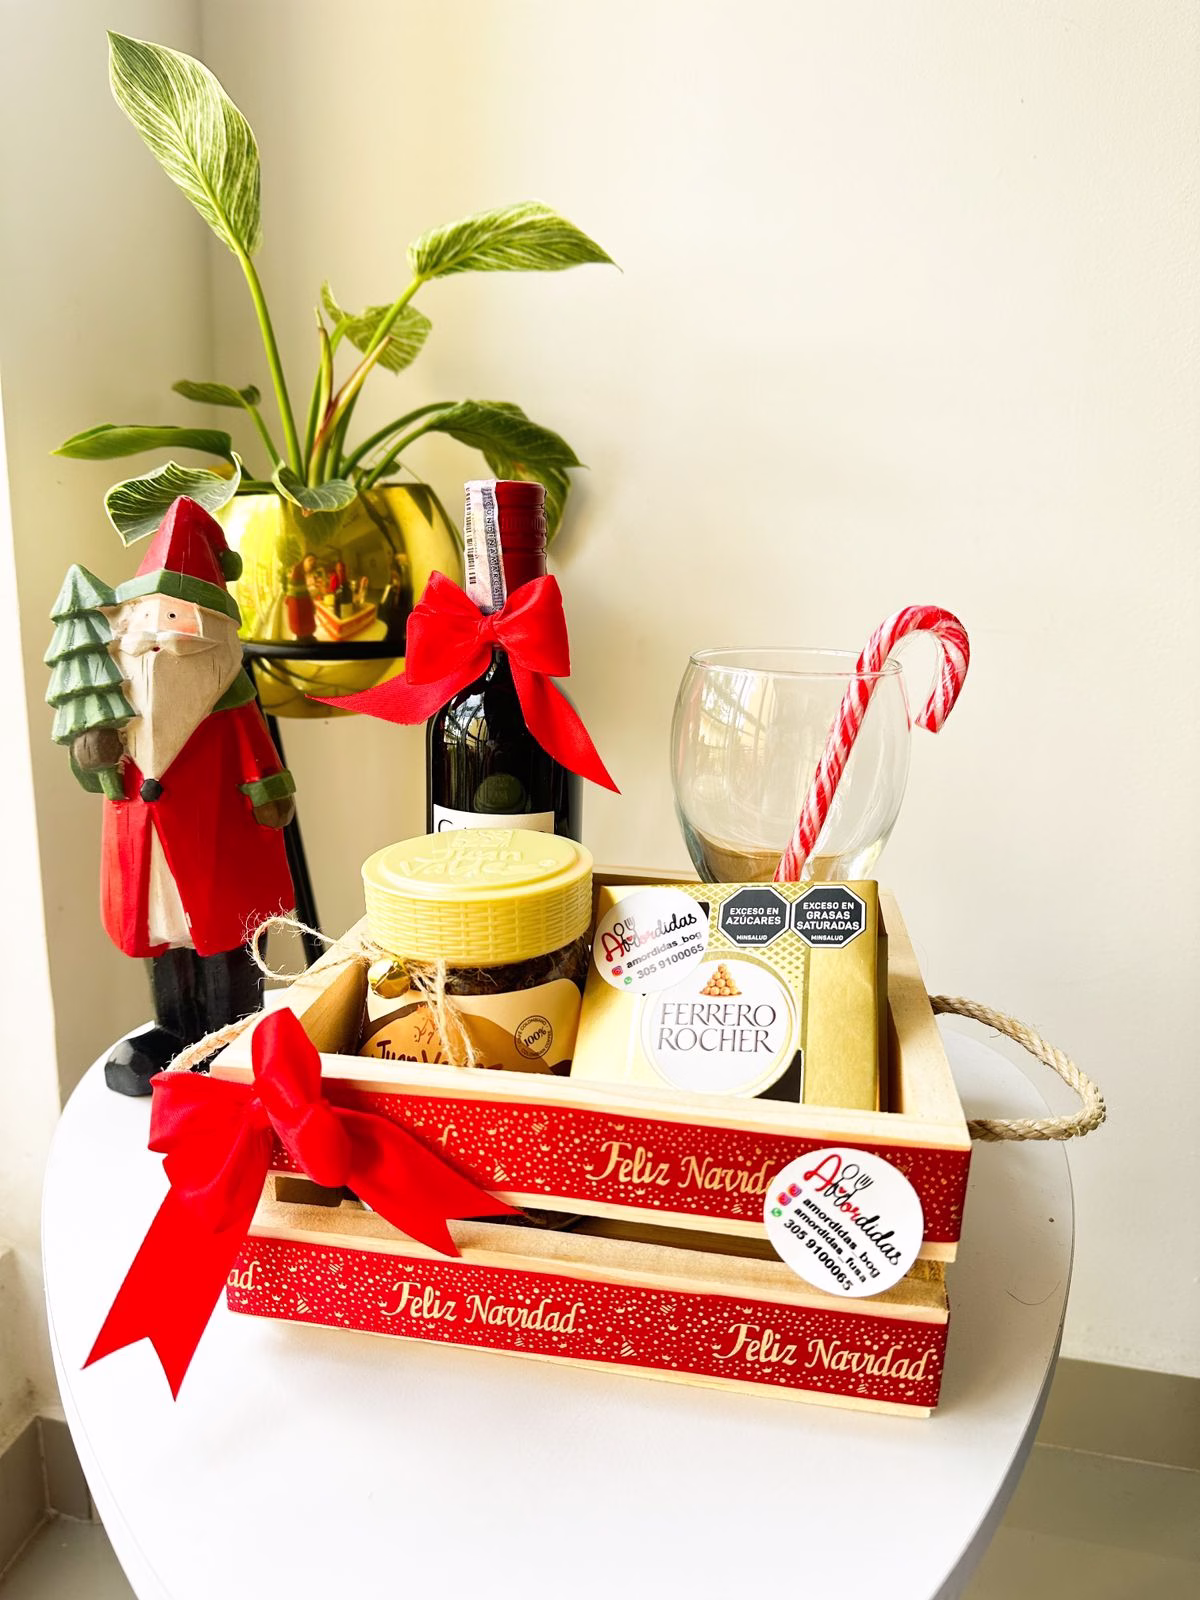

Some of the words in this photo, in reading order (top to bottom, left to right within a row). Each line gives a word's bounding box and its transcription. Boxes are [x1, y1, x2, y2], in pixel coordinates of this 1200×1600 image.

[486, 501, 501, 595] CUNDINAMARCA
[729, 907, 765, 915] EXCESO
[766, 907, 779, 915] EN
[802, 902, 839, 910] EXCESO
[841, 902, 855, 910] EN
[806, 911, 851, 920] GRASAS
[725, 914, 782, 925] AZÚCARES
[796, 921, 860, 930] SATURADAS
[636, 964, 657, 979] 305
[659, 943, 705, 969] 9100065
[660, 1002, 776, 1027] FERRERO
[524, 1026, 547, 1047] 100%
[657, 1027, 774, 1053] ROCHER
[585, 1140, 671, 1186] Feliz
[678, 1155, 775, 1195] Navid
[784, 1218, 808, 1240] 305
[805, 1238, 854, 1291] 9100065
[380, 1280, 457, 1321] Feliz
[464, 1295, 584, 1335] Navidad
[712, 1322, 798, 1367] Feliz
[804, 1338, 937, 1382] Navidad
